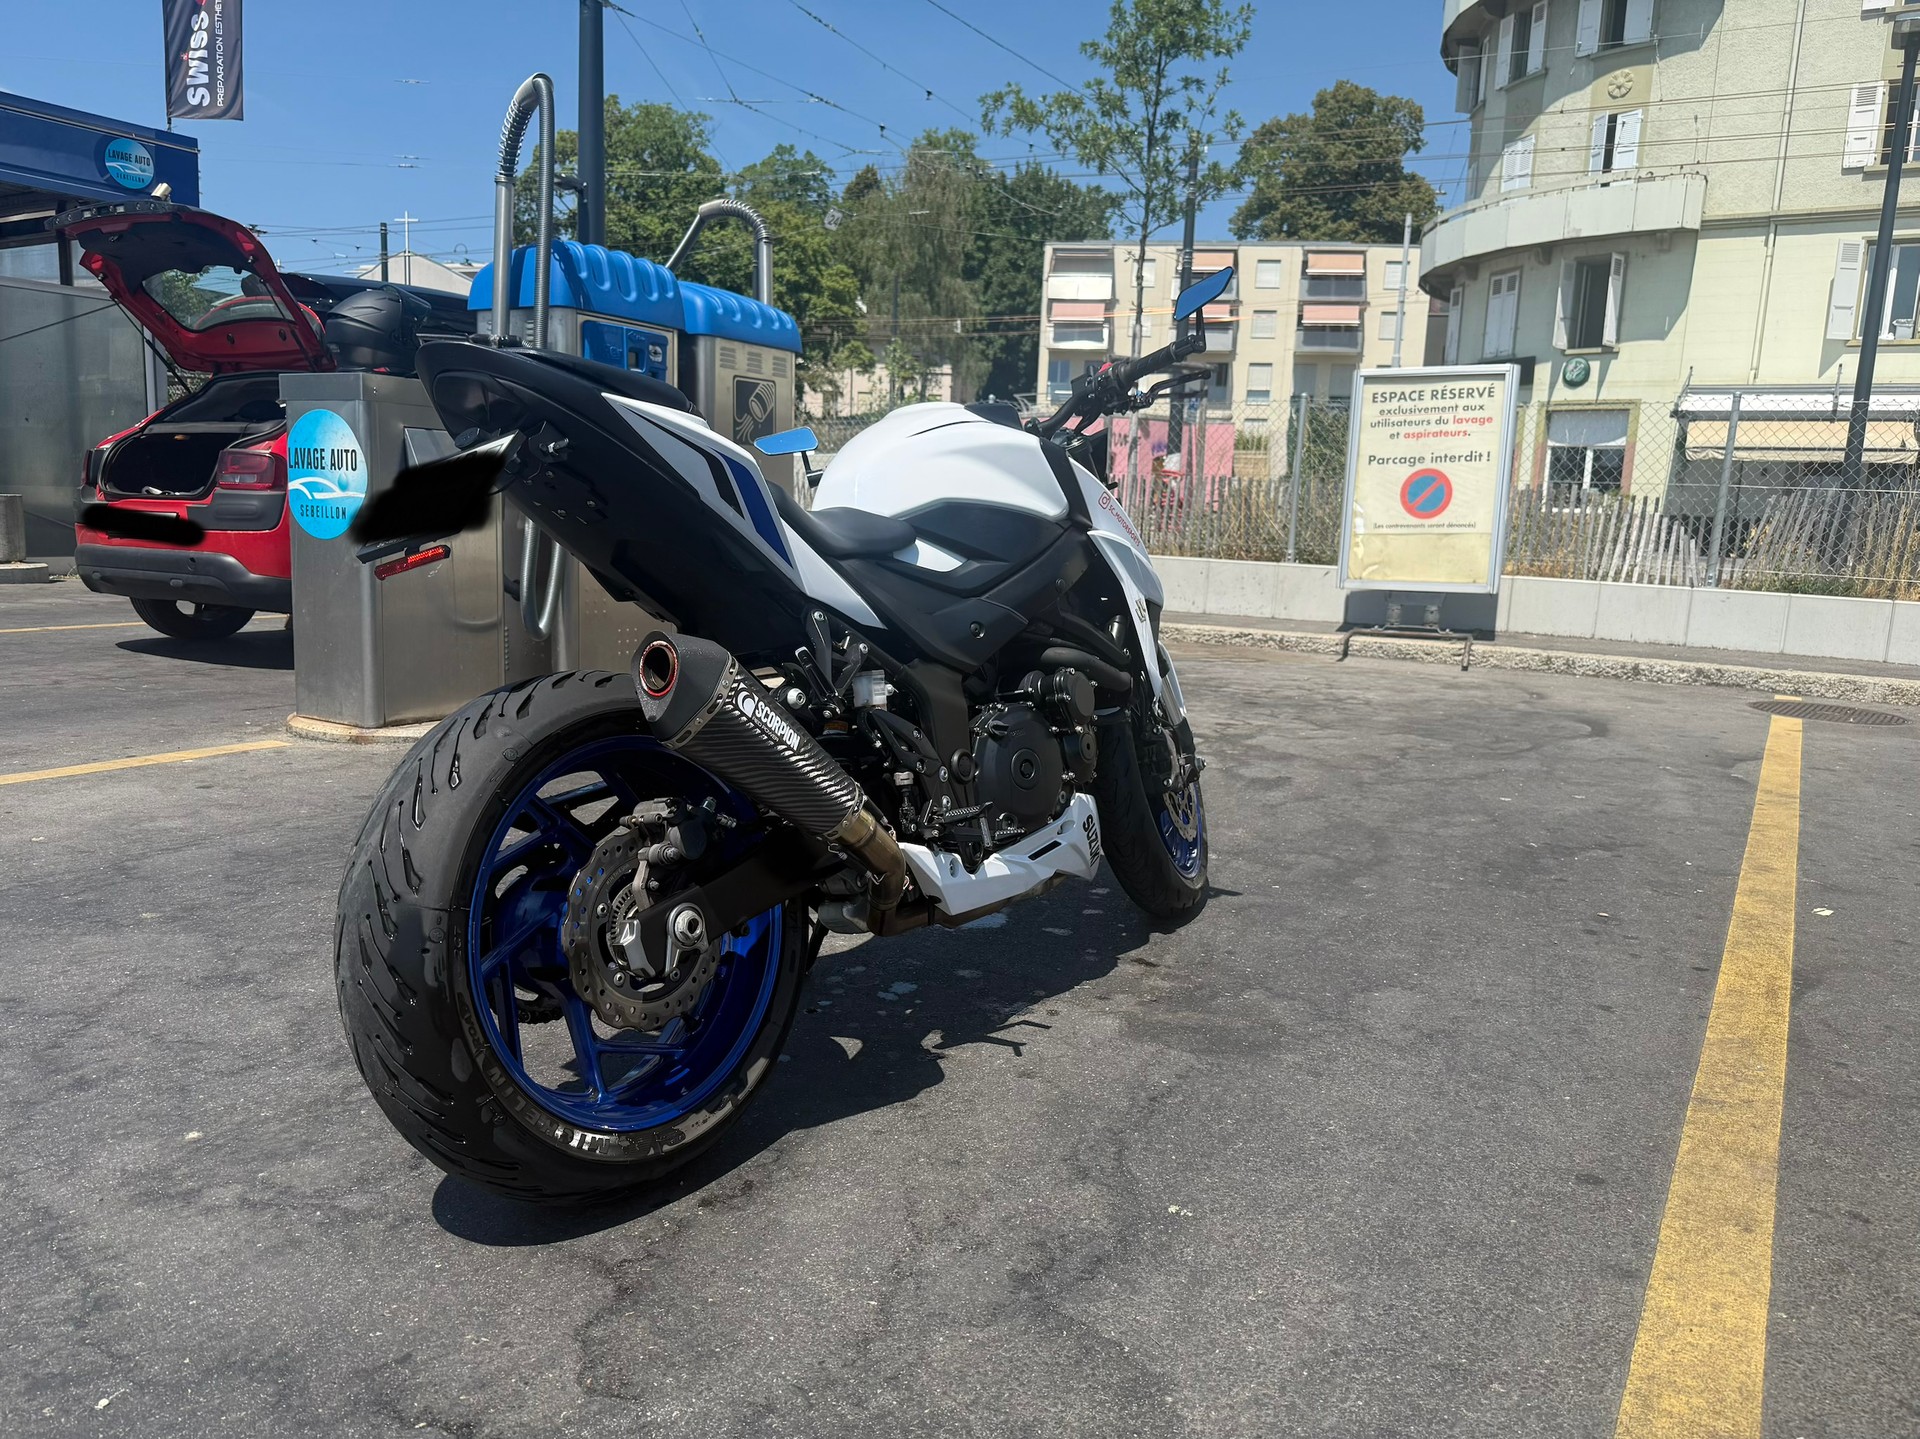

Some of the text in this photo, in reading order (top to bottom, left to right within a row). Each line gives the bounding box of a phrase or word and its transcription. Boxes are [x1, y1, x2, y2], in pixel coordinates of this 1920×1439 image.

[108, 149, 151, 167] LAVAGE AUTO
[1372, 383, 1496, 404] ESPACE RÉSERVÉ
[1379, 403, 1485, 416] exclusivement aux
[1370, 415, 1493, 429] utilisateurs du lavage
[1389, 429, 1471, 442] et aspirateurs.
[288, 447, 358, 472] LAVAGE AUTO
[1368, 454, 1426, 468] Parcage
[300, 503, 347, 520] SEBEILLON
[755, 701, 801, 751] SCORPION
[1082, 813, 1100, 868] SUZUKI
